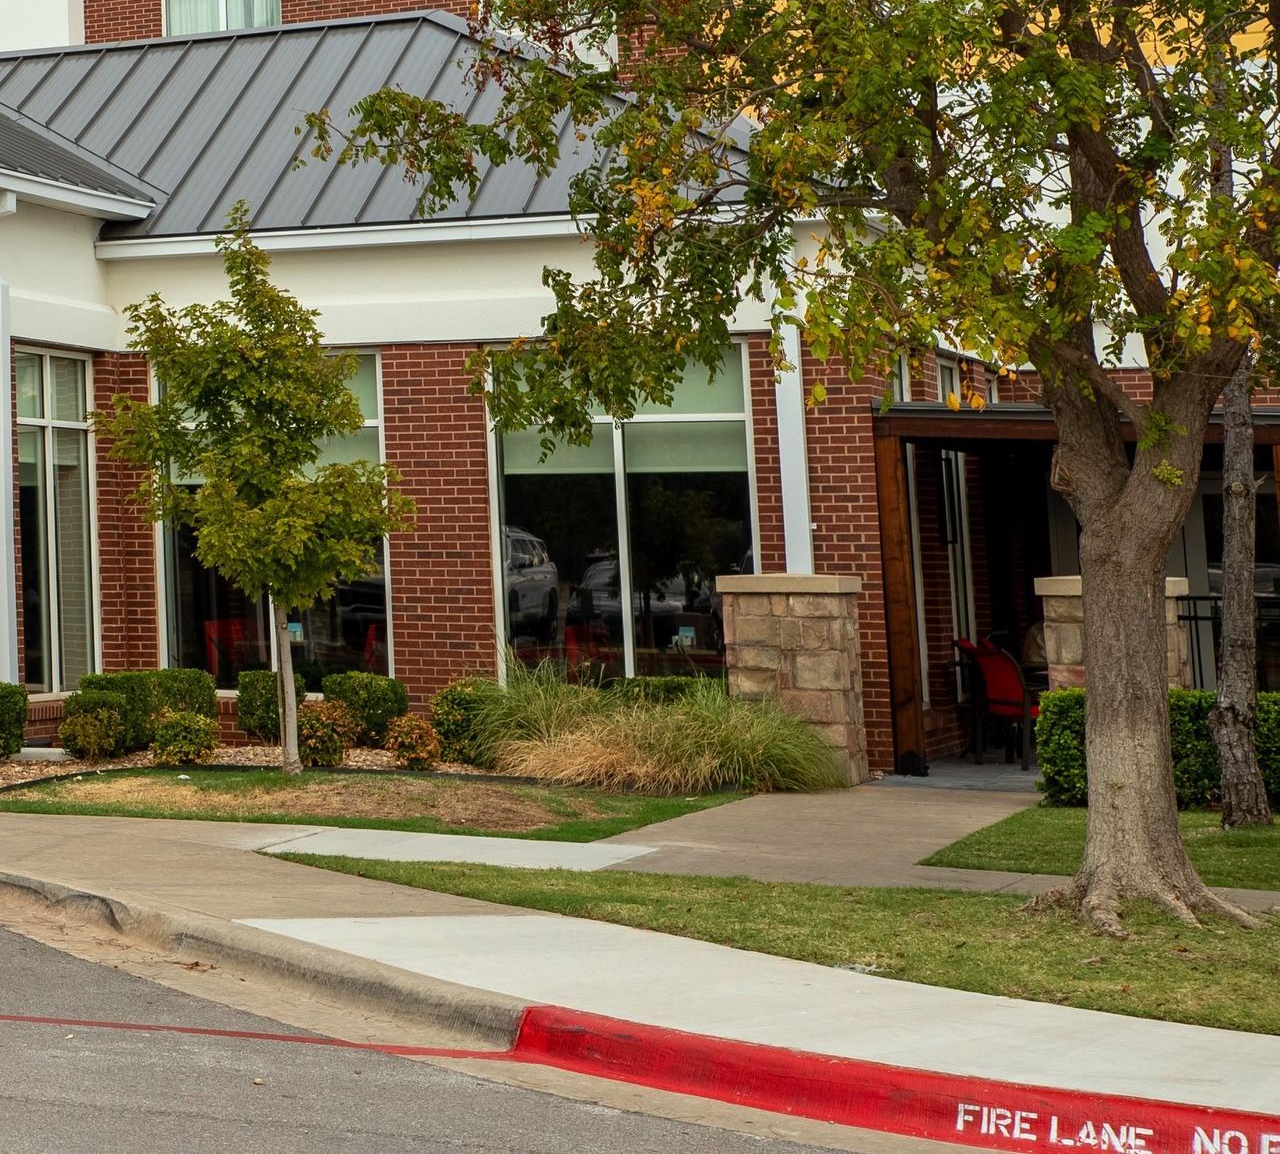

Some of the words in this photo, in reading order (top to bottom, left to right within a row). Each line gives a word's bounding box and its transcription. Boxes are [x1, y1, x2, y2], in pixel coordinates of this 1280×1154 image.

[955, 1103, 1038, 1142] FIRE
[1049, 1115, 1154, 1154] LANE
[1193, 1126, 1249, 1154] NO
